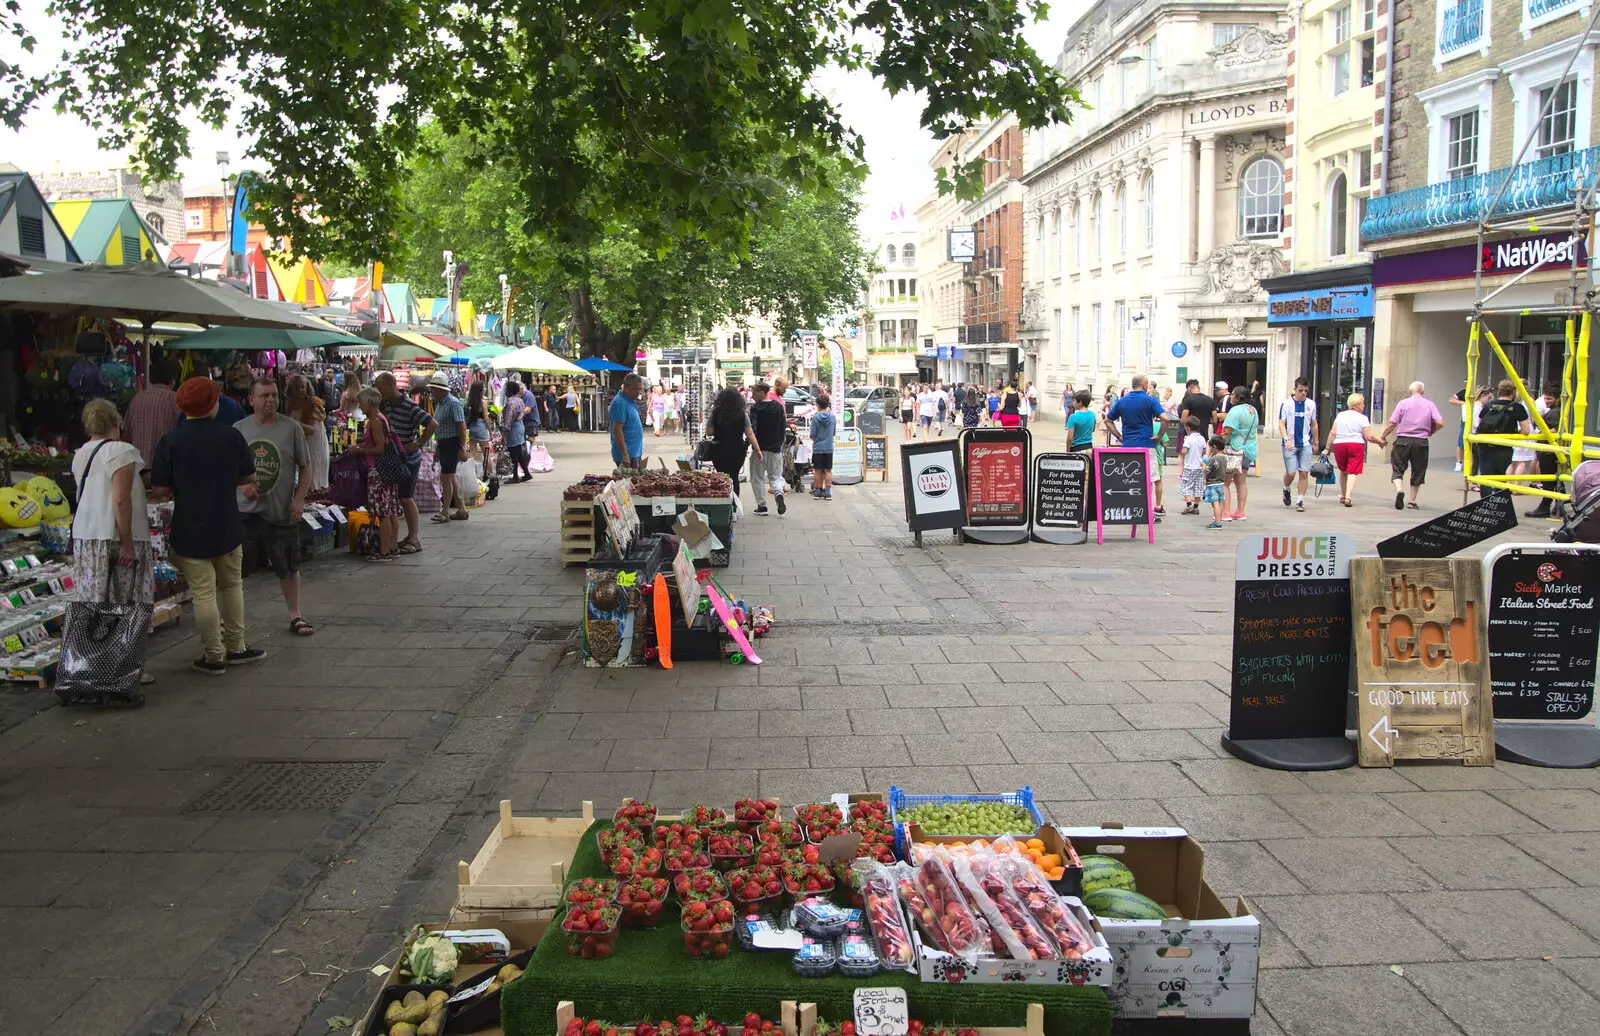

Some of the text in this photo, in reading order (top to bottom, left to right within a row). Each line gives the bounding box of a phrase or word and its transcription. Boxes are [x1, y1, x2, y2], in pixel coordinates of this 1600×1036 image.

[1190, 98, 1288, 124] LLOYDS BA
[1110, 121, 1152, 157] LIMITED
[1496, 235, 1575, 268] NatWest
[1246, 346, 1267, 354] BANK
[971, 447, 992, 459] Coffee
[920, 474, 949, 483] VEGAN
[1064, 479, 1082, 487] Bread,
[923, 482, 948, 490] DINER
[1040, 486, 1082, 495] Pastries, Cakes,
[1062, 502, 1078, 510] Stalls
[1488, 495, 1510, 505] CUBAN
[1133, 506, 1144, 518] 50
[1453, 510, 1472, 520] STREET
[1257, 536, 1328, 560] JUICE
[1257, 536, 1337, 578] PRESS BAGUETTES
[1238, 584, 1271, 604] FRESH
[1390, 574, 1436, 612] the
[1515, 582, 1582, 598] Sicily Market
[1499, 597, 1595, 609] Italian Street Food
[1239, 616, 1344, 631] SMOOTHIES MADE ONLY WITH
[1240, 626, 1331, 643] NATURAL INGREDIENTS
[1366, 600, 1478, 668] feed
[1237, 654, 1292, 676] BAGUETTES
[1295, 652, 1314, 673] WITH
[1240, 668, 1297, 689] OF FILLING
[1242, 695, 1286, 707] MEAL DEALS
[1368, 689, 1470, 707] GOOD TIME EATS
[1545, 691, 1590, 705] STALL 34
[1546, 703, 1581, 713] OPEN
[1143, 966, 1213, 979] Reina de Casi
[1158, 981, 1186, 992] CASI
